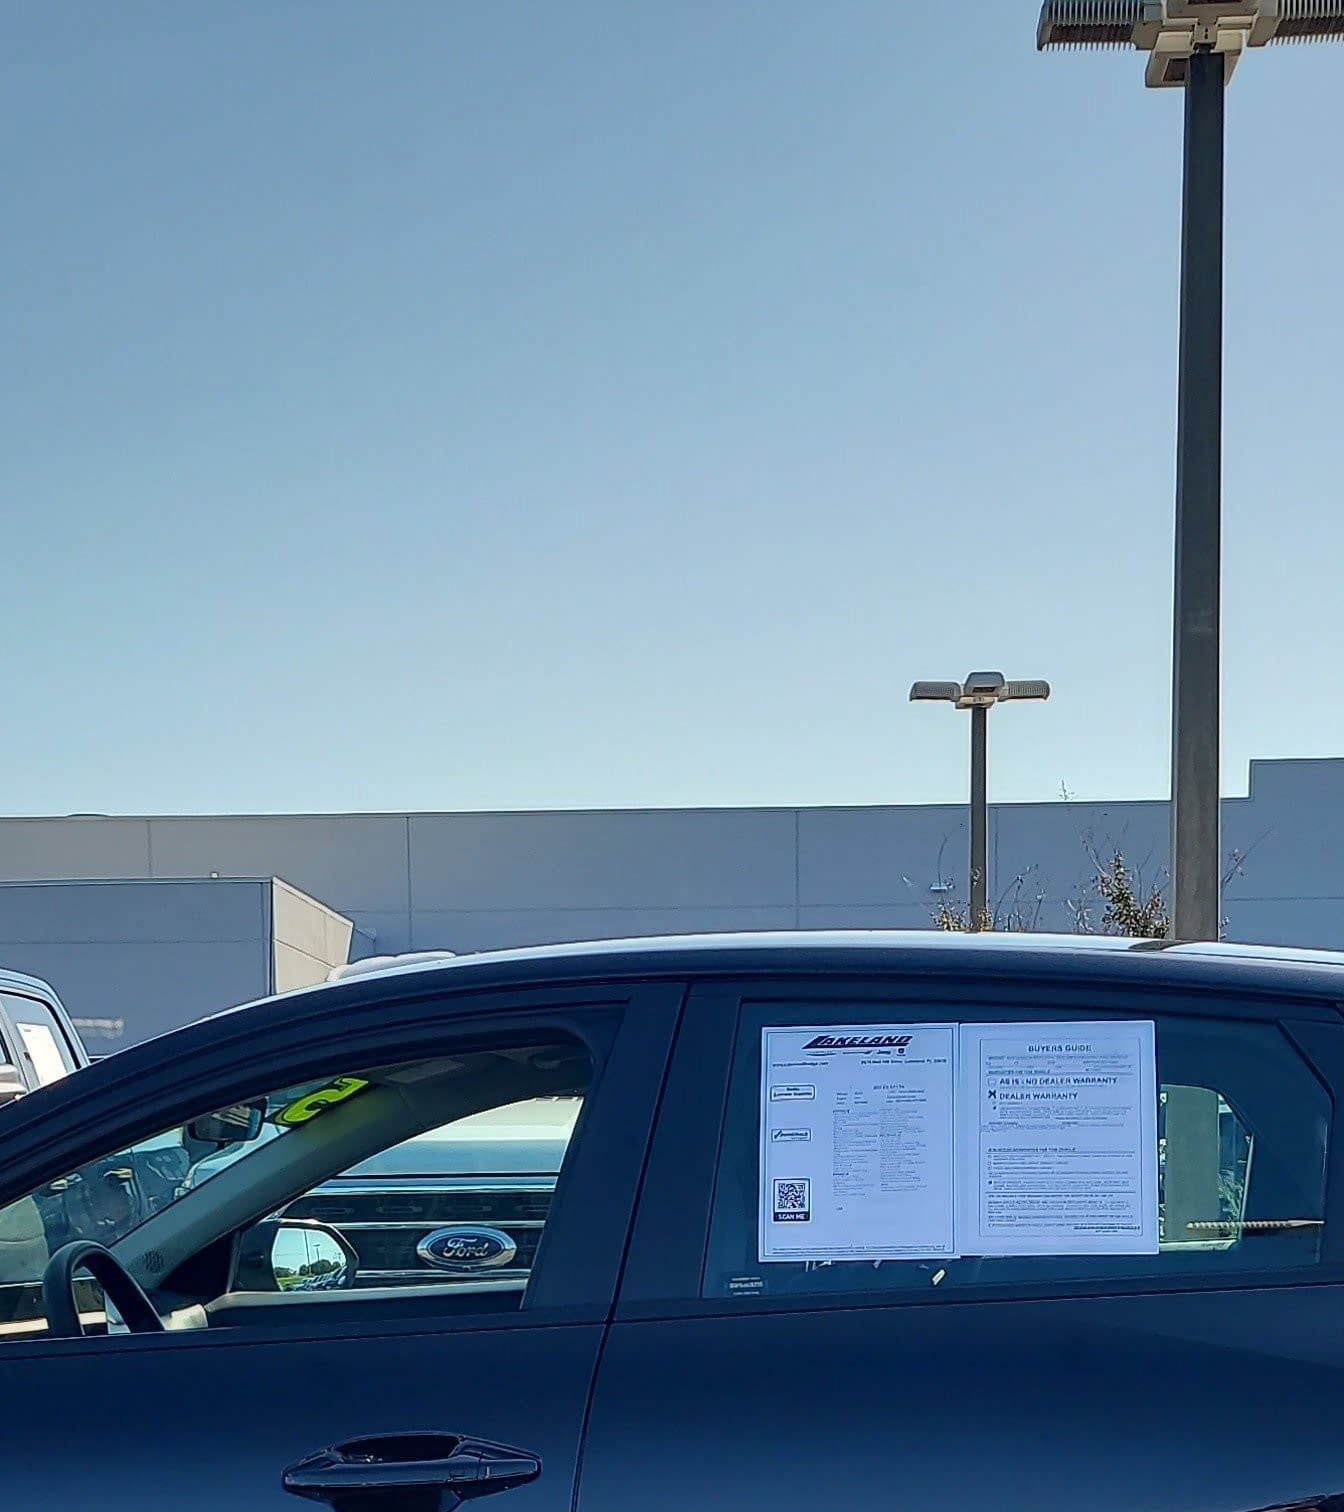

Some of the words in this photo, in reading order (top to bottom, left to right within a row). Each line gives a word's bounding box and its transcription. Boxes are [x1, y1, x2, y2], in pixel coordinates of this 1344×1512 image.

[802, 1035, 913, 1049] LAKELAND
[1028, 1045, 1063, 1053] BUYERS
[1065, 1044, 1093, 1052] GUIDE
[1073, 1076, 1118, 1085] WARRANTY
[1033, 1092, 1078, 1100] WARRANTY
[443, 1237, 489, 1257] Ford
